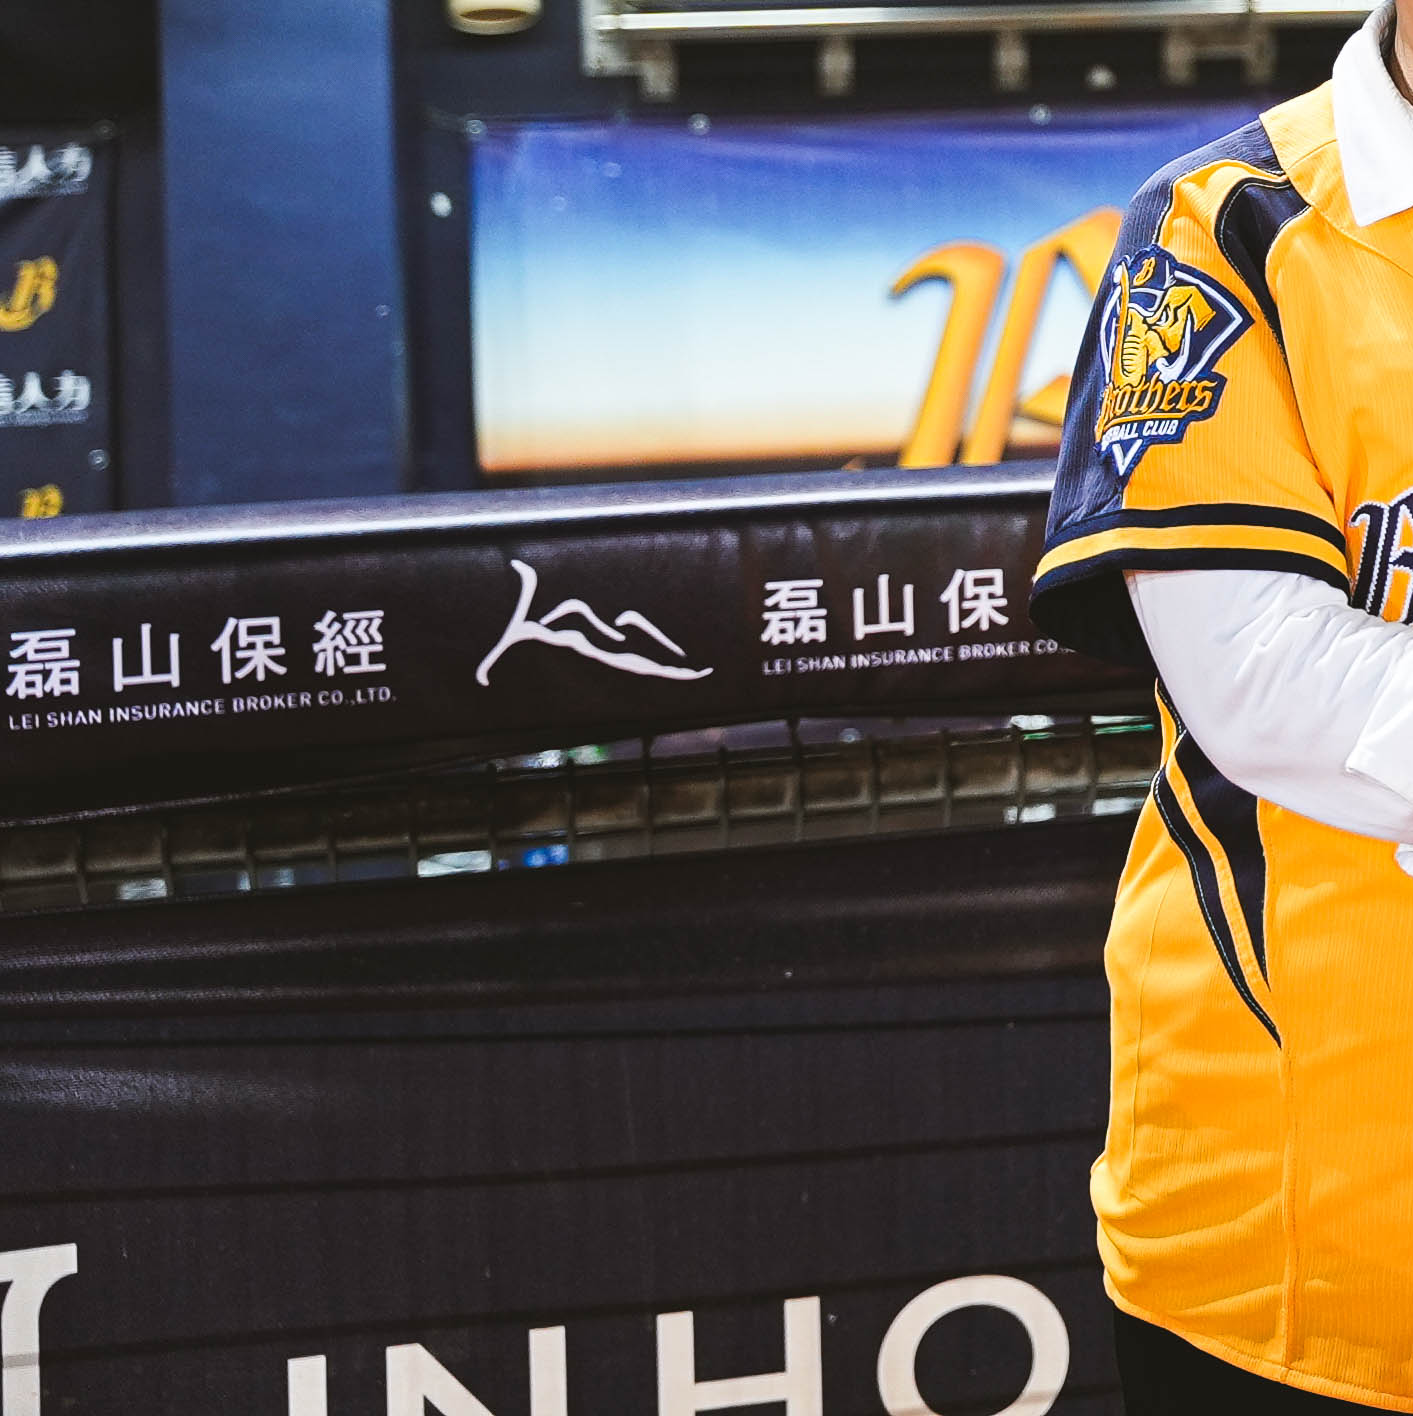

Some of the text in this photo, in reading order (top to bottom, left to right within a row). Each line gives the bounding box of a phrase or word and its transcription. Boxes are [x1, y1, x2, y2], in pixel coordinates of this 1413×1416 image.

[1142, 419, 1179, 437] CLUB
[5, 610, 388, 699] 磊山保經
[761, 660, 792, 675] LEI
[797, 655, 846, 672] SHAN
[850, 646, 954, 669] INSURANCE
[957, 641, 1030, 661] BROKER
[9, 685, 398, 731] LEI SHAN INSURANCE BROKER CO.,LTD.
